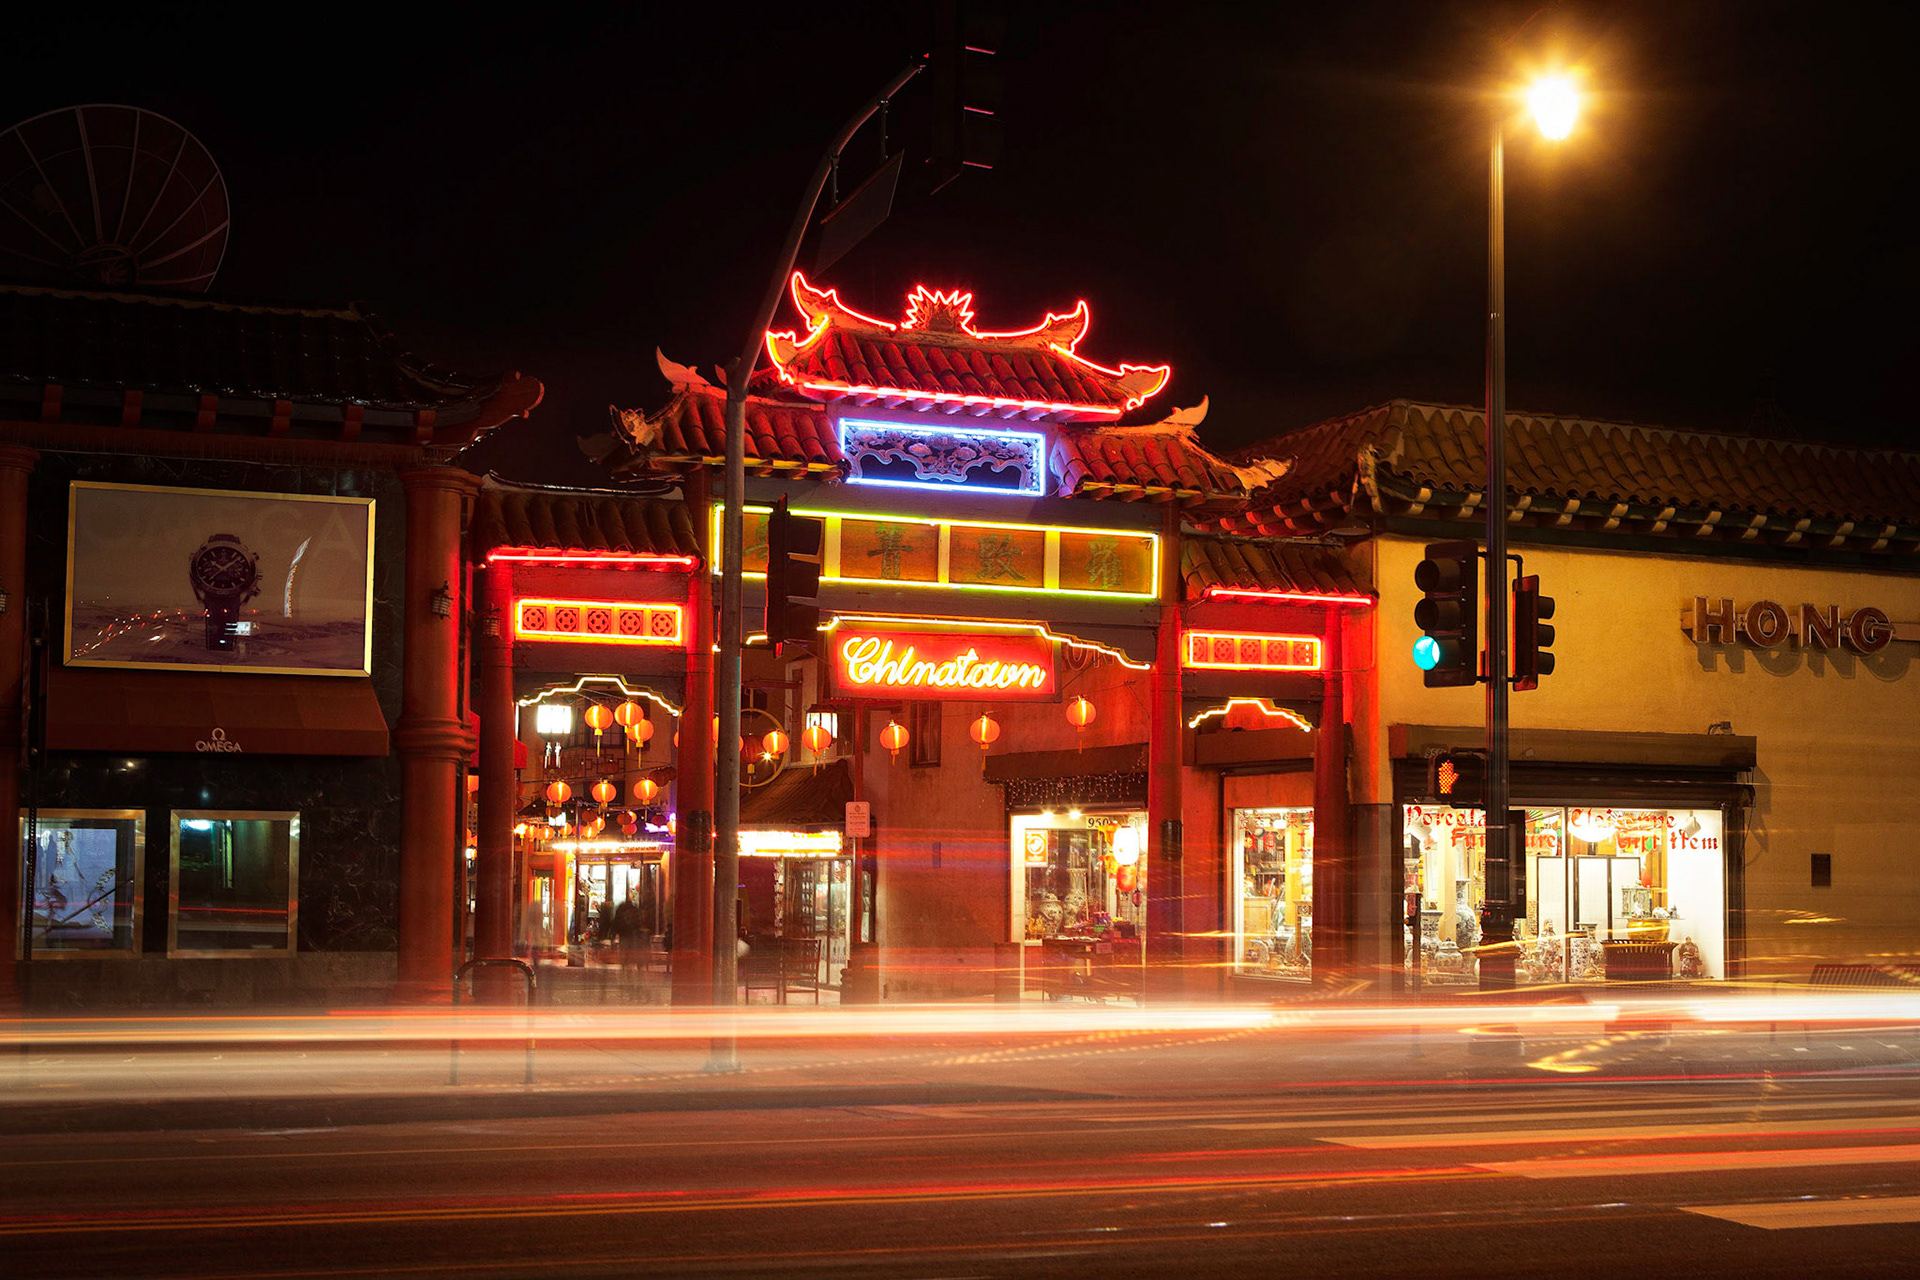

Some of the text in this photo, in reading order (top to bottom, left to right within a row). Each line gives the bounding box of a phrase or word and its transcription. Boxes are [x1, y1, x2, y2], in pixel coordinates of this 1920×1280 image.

[1693, 596, 1894, 654] HONG
[843, 636, 1047, 689] Chinatown
[195, 740, 243, 753] OMEGA
[1406, 805, 1487, 826] Porcela
